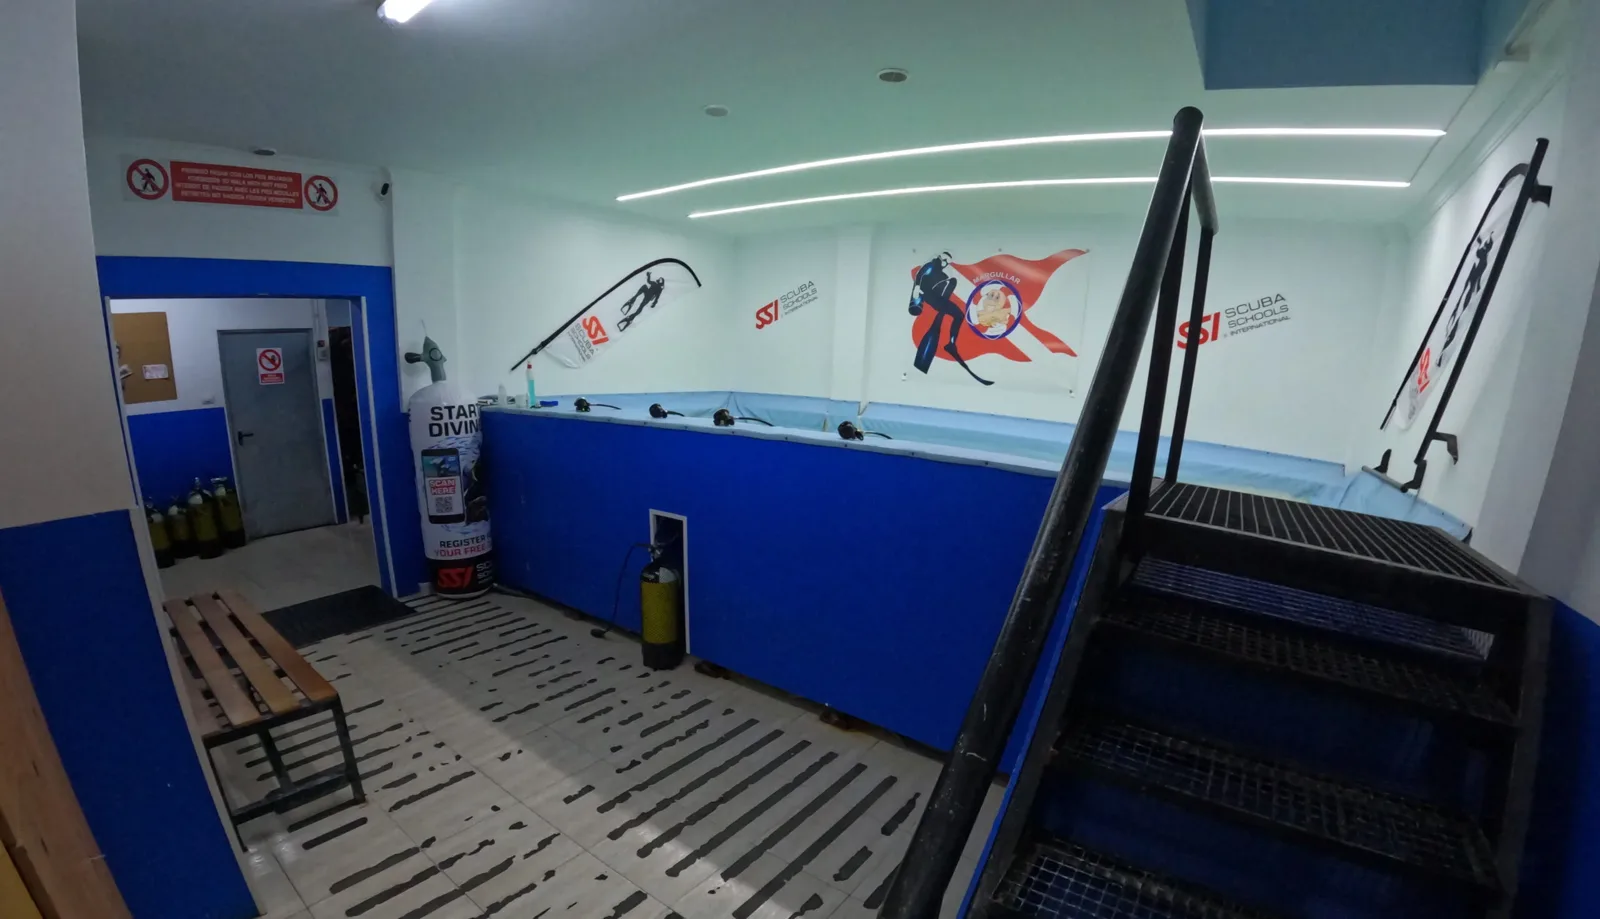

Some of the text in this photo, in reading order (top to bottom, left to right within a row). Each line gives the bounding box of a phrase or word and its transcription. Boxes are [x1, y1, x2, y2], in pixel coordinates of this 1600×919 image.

[973, 271, 1021, 284] MARGULLAR
[780, 280, 815, 303] SCUBA
[755, 299, 779, 330] SSI
[1225, 293, 1286, 318] SCUBA
[1228, 304, 1289, 328] SCHOOLS
[1230, 315, 1291, 336] INTERNATIONAL
[434, 543, 486, 557] YOUR FREE
[440, 534, 485, 548] REGISTER
